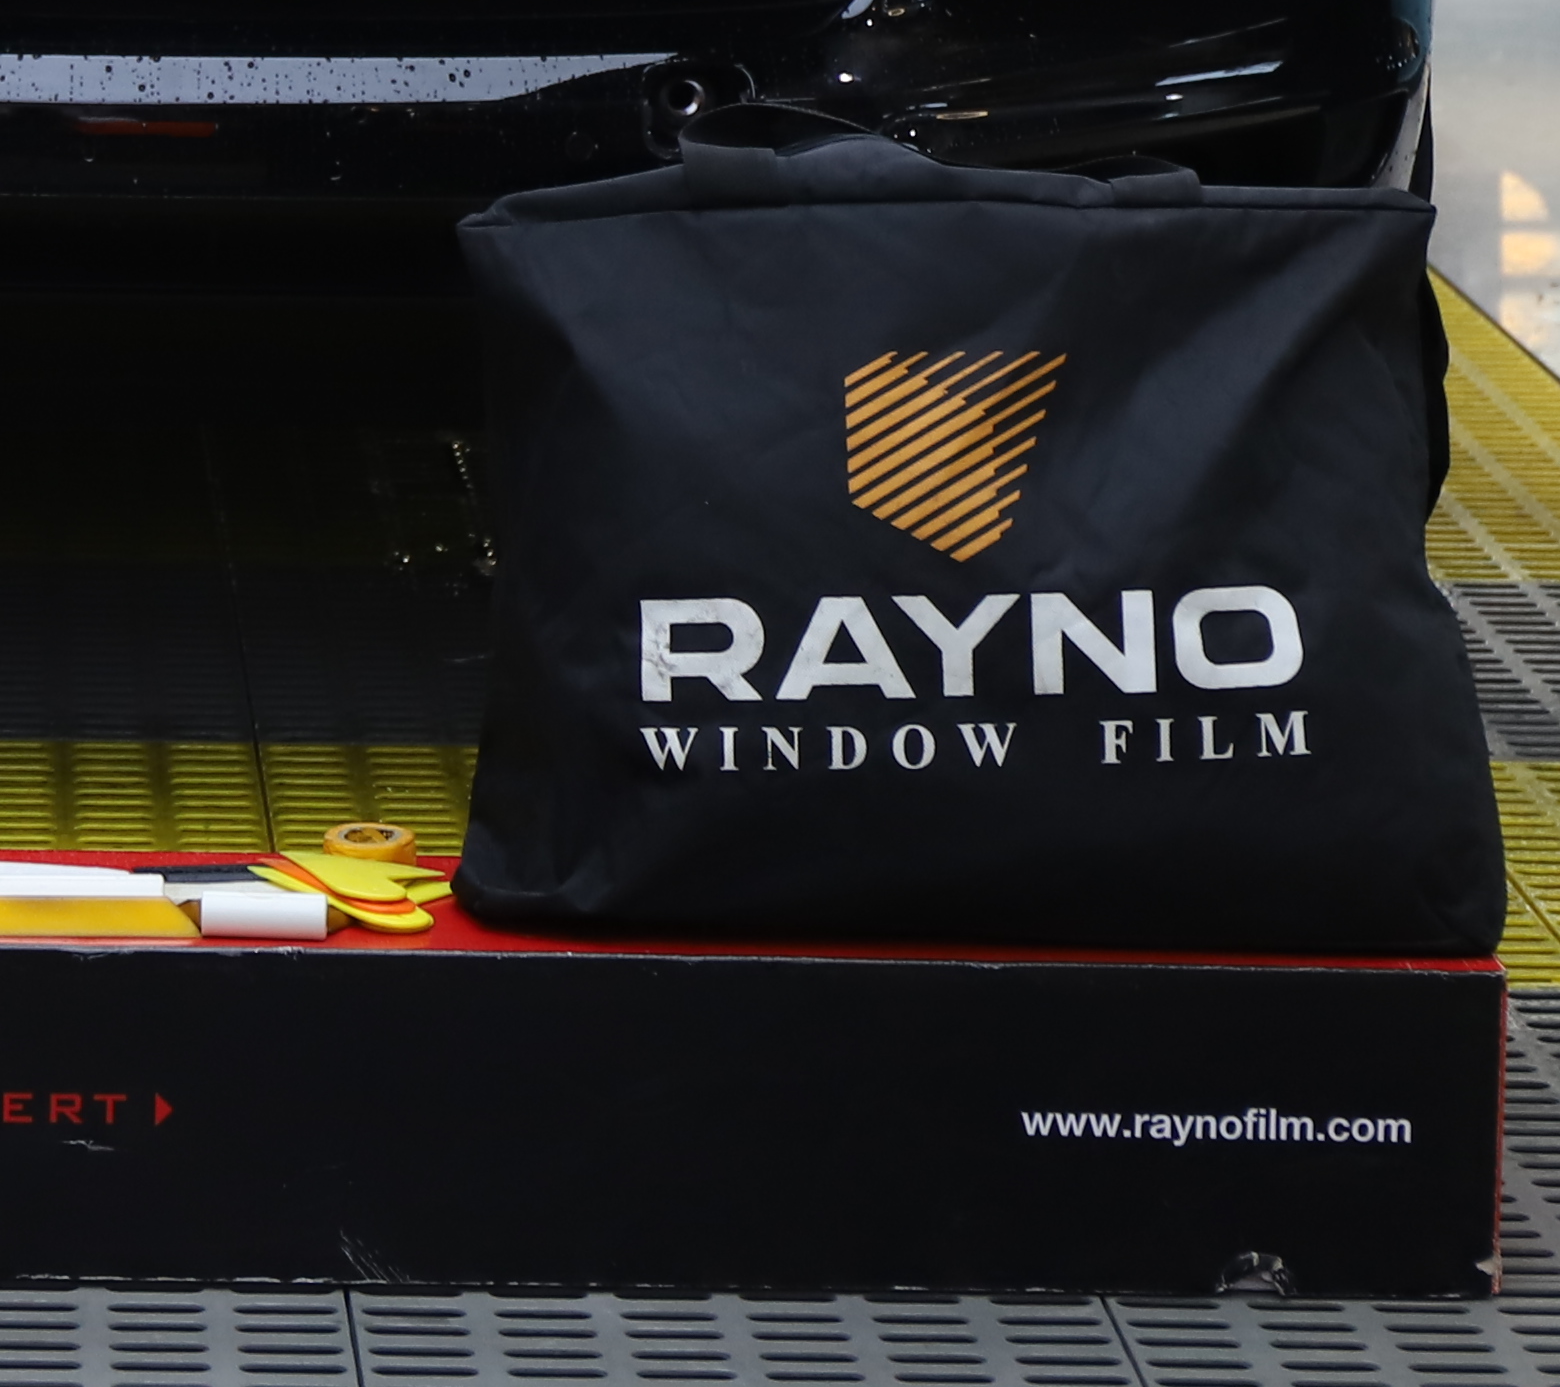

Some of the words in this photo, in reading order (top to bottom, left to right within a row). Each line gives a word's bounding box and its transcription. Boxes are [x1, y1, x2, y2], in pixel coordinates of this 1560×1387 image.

[639, 585, 1305, 702] RAYNO
[640, 721, 1017, 773] WINDOW
[1100, 710, 1312, 765] FILM
[1021, 1108, 1413, 1147] www.raynofilm.com
